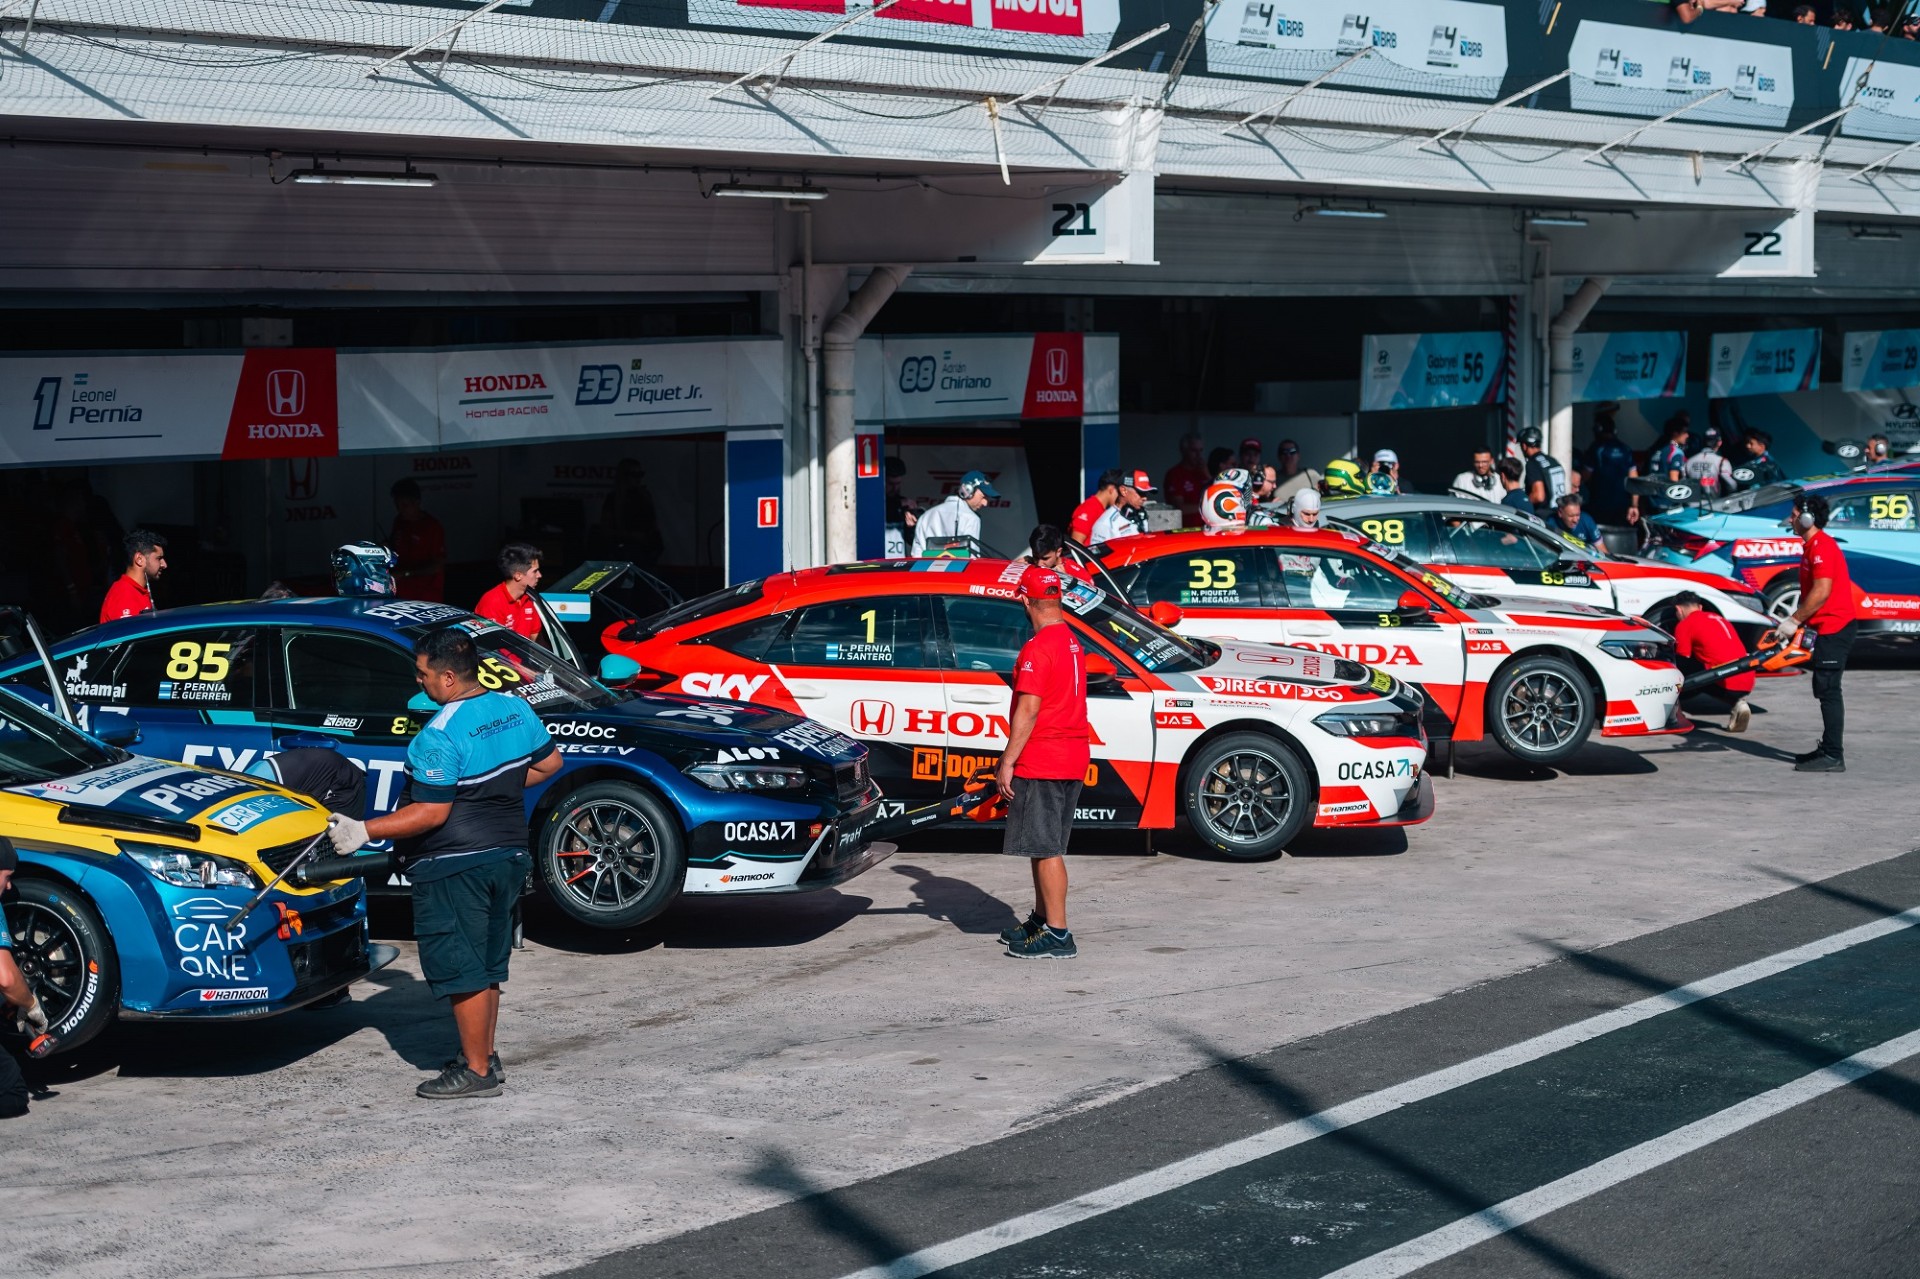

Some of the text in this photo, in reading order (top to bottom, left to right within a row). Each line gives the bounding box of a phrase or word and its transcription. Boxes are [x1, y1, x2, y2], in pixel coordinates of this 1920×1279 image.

[1243, 1, 1274, 27] F4
[1286, 20, 1304, 37] BRB
[1341, 13, 1369, 38] F4
[1381, 31, 1397, 48] BRB
[1430, 25, 1457, 48] F4
[1467, 41, 1482, 57] BRB
[1597, 48, 1620, 70] F4
[1668, 56, 1691, 77] F4
[1629, 62, 1643, 78] BRB
[1736, 64, 1756, 84] F4
[1052, 203, 1096, 236] 21
[1744, 232, 1781, 255] 22
[1463, 352, 1484, 383] 56
[1641, 352, 1658, 379] 27
[1775, 348, 1796, 374] 115
[464, 374, 547, 393] HONDA
[629, 373, 664, 385] Nelson
[899, 356, 936, 393] 88
[940, 375, 991, 390] Chiriano
[575, 364, 623, 406] 33
[33, 377, 62, 430] 1
[72, 389, 116, 402] Leonel
[627, 384, 703, 405] Piquet Jr.
[1036, 391, 1077, 402] HONDA
[69, 404, 143, 424] Pernía
[466, 405, 548, 418] Honda RACING
[248, 424, 324, 438] HONDA
[413, 457, 472, 472] HONDA
[554, 465, 620, 480] HOND
[285, 506, 337, 522] ONDA
[1871, 496, 1908, 519] 56
[1735, 541, 1804, 557] AXALTA
[1189, 560, 1236, 589] 33
[987, 587, 1023, 599] add
[1873, 598, 1920, 609] Santander
[860, 609, 876, 644] 1
[1378, 614, 1400, 627] 33
[838, 644, 891, 653] L. PERNIA
[1470, 643, 1502, 651] JAS
[166, 641, 231, 681] 85
[838, 652, 893, 661] J. SANTERO
[172, 682, 226, 692] T. PERNIA
[680, 673, 770, 701] SKY
[1212, 679, 1291, 695] DIRECTV
[1635, 686, 1674, 696] JORLAN
[171, 692, 231, 701] E. GUERRERI
[336, 718, 357, 729] BRB
[469, 713, 521, 737] URUGUAY
[1156, 716, 1193, 725] JAS
[547, 721, 617, 739] addoc
[556, 743, 636, 756] RECTV
[716, 746, 781, 764] ALOT
[1338, 760, 1395, 780] OCASA
[140, 775, 252, 814] Plane
[221, 808, 255, 827] CAR
[1074, 809, 1116, 820] RECTV
[725, 821, 780, 841] OCASA
[174, 924, 247, 952] CAR
[180, 955, 250, 981] ONE
